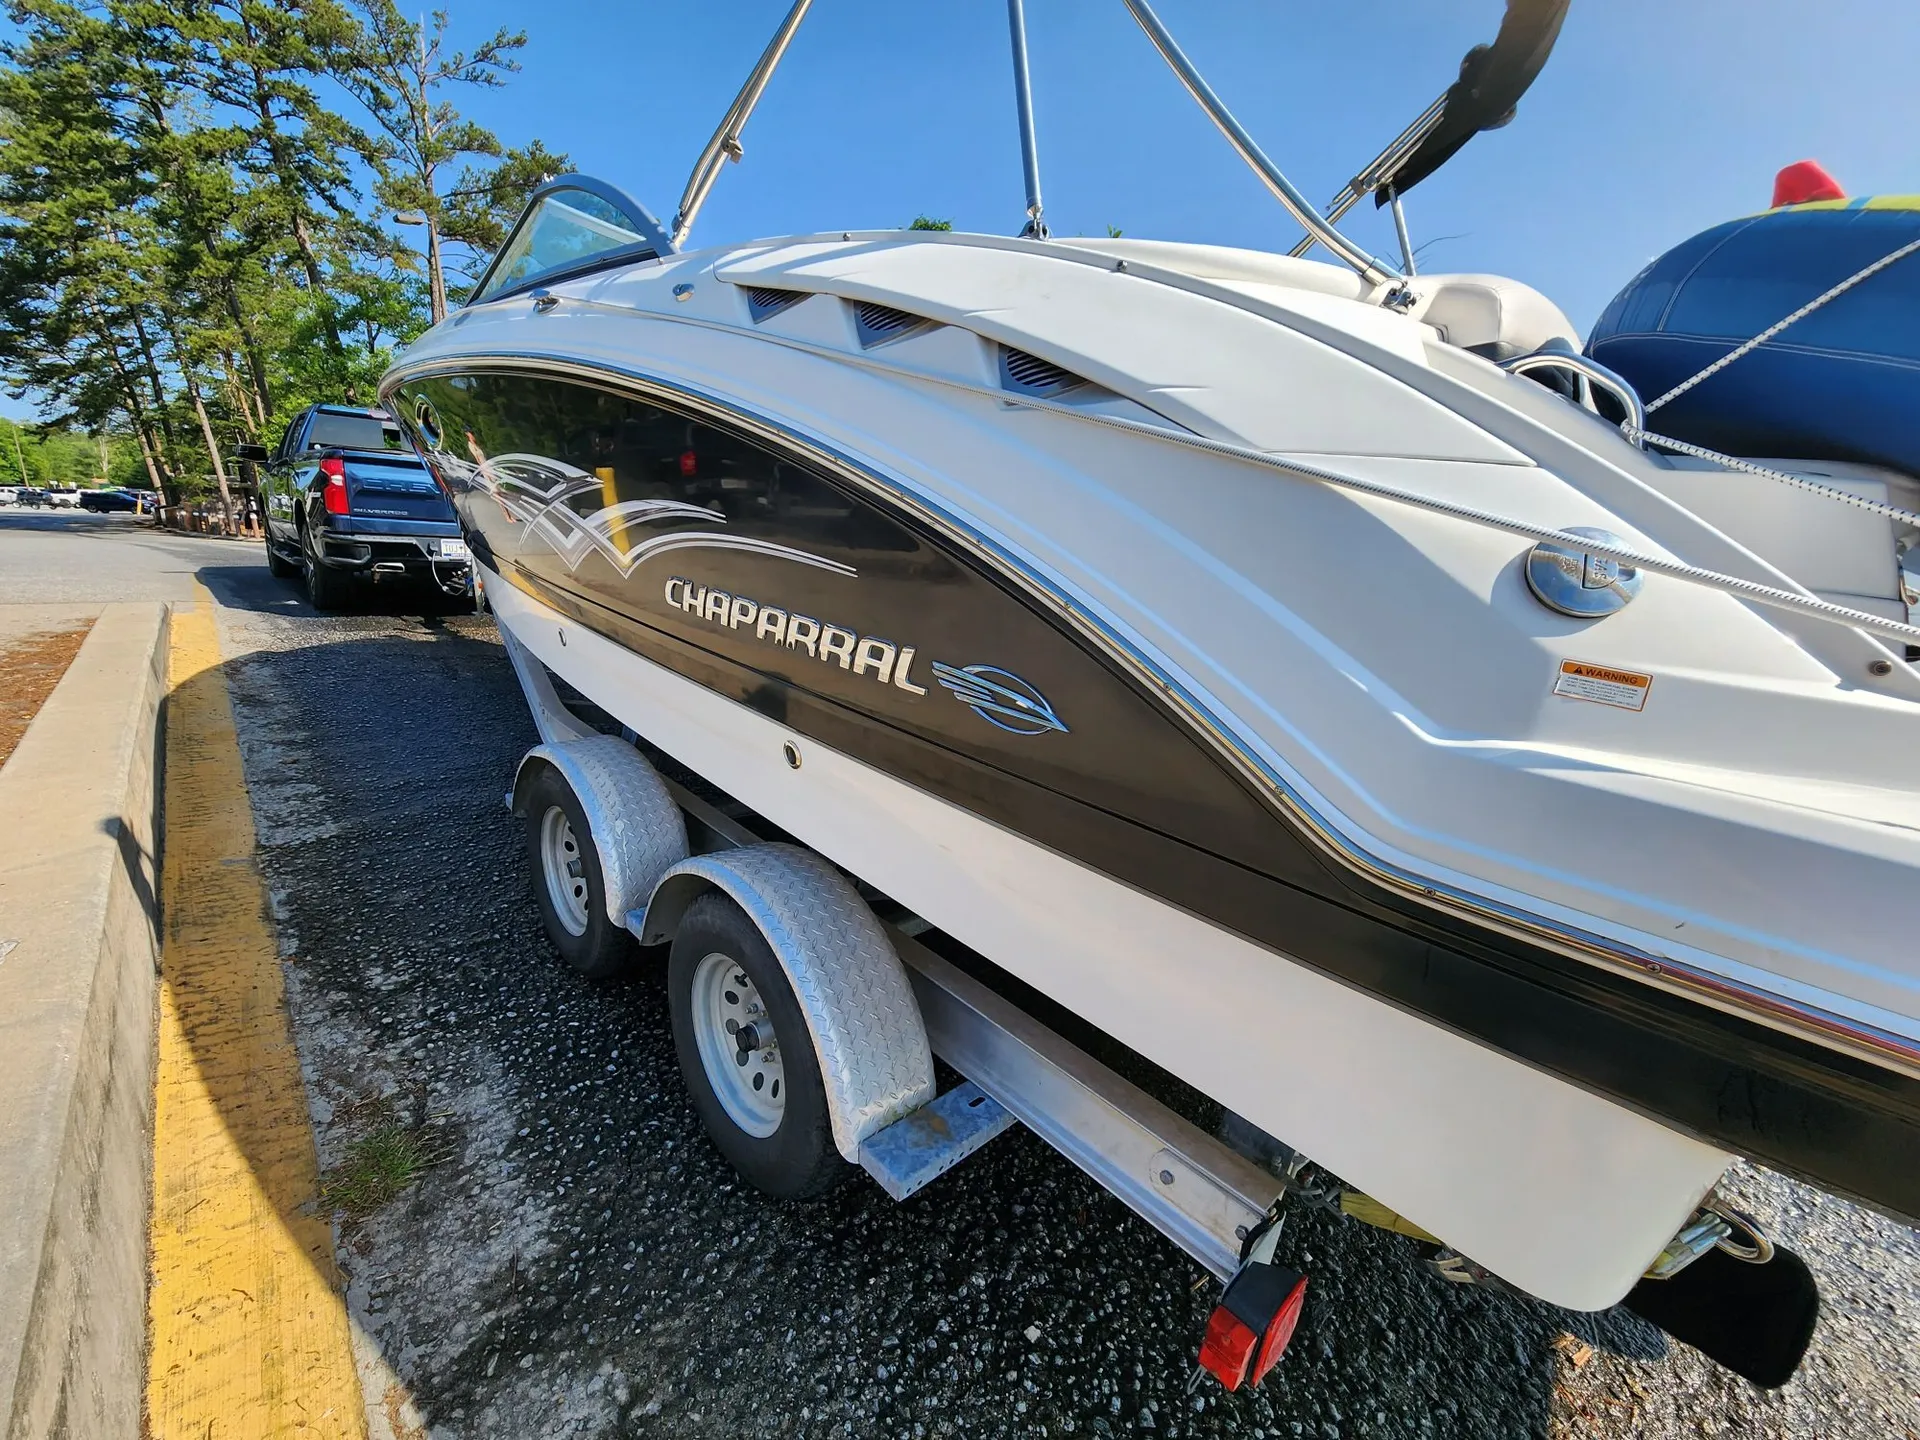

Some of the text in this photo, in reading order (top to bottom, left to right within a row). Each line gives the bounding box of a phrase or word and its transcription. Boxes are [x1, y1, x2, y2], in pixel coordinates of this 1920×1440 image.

[353, 507, 408, 516] SILVERADO
[664, 575, 929, 697] CHAPARRAL
[1586, 667, 1638, 685] WARNING
